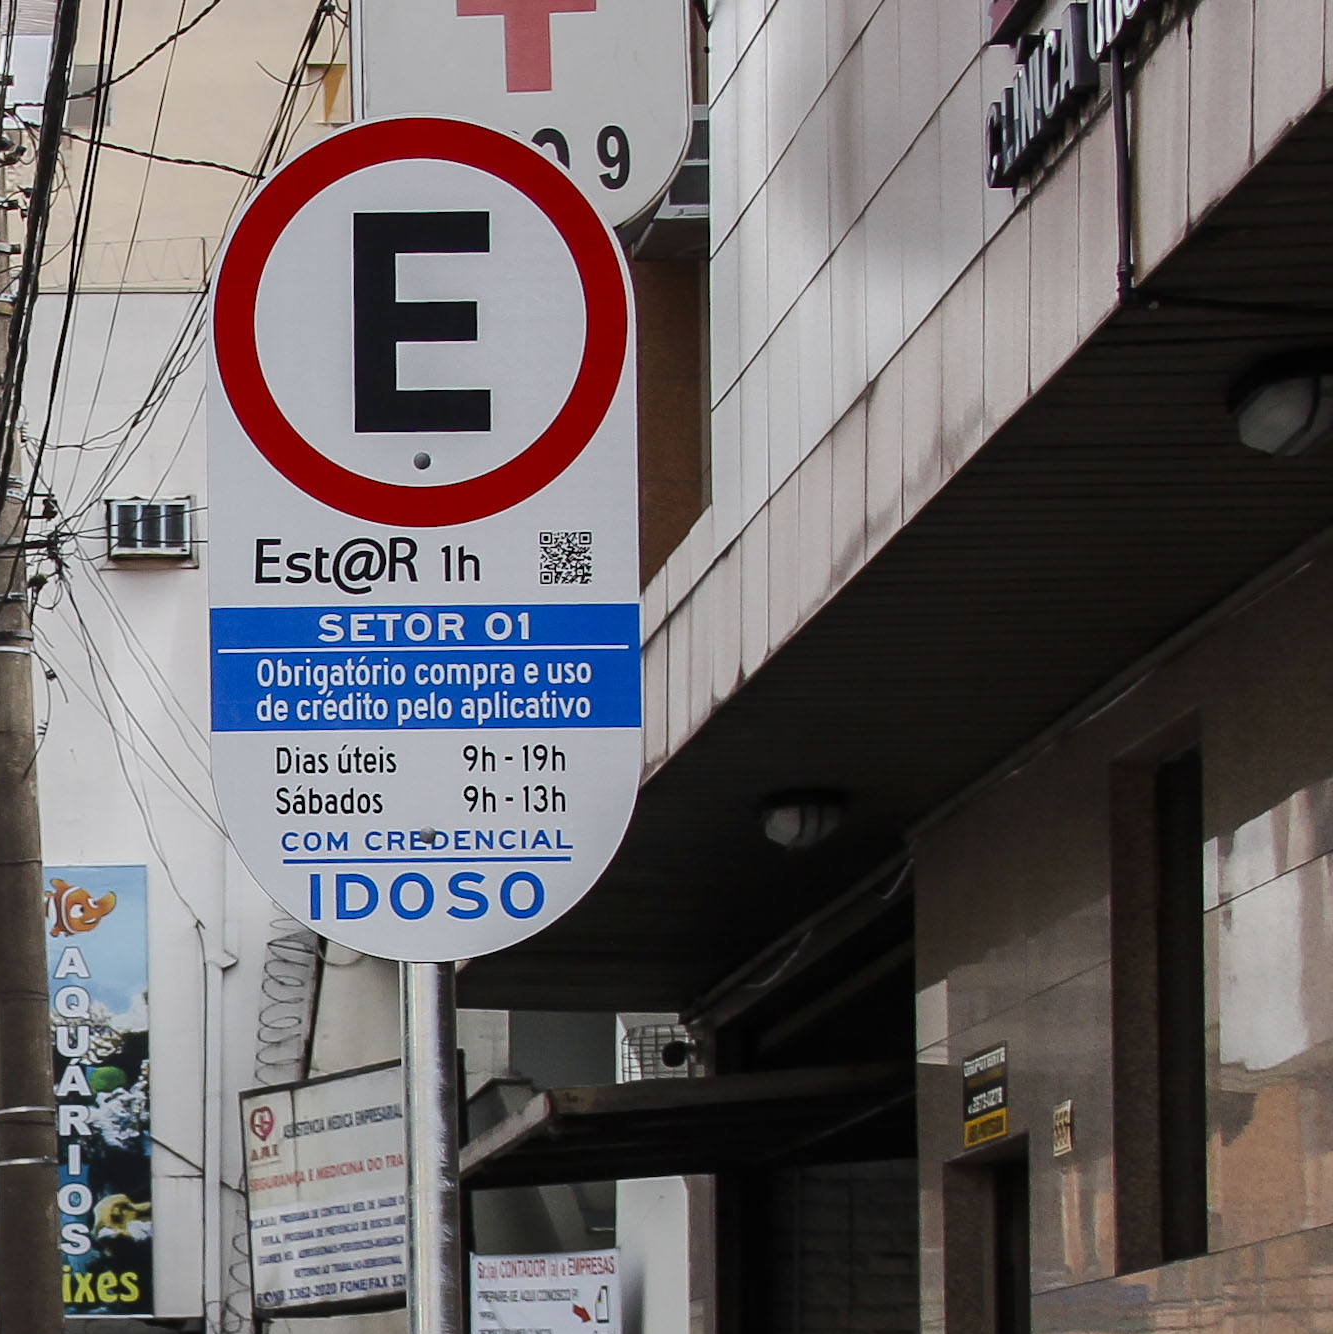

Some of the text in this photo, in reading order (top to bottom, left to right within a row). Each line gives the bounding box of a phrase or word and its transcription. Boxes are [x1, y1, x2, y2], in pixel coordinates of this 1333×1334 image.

[353, 211, 491, 432] E
[254, 536, 481, 594] Est@R 1h
[318, 611, 530, 642] SETOR 01
[256, 656, 591, 695] Obrigatório compra e uso
[256, 689, 591, 726] de crédito pelo aplicativo
[276, 743, 397, 774] Dias úteis
[463, 745, 496, 773] 9h
[522, 743, 567, 772] 19h
[276, 784, 384, 815] Sábados
[463, 785, 496, 814] 9h
[522, 785, 567, 813] 13h
[281, 829, 573, 852] COM CREDENCIAL
[309, 870, 545, 921] IDOSO
[54, 946, 93, 1257] AQUÁRIOS
[316, 1159, 364, 1181] MEDICINA
[366, 1156, 382, 1172] DO
[500, 1258, 546, 1279] CONTADOR
[567, 1256, 615, 1276] EMPRESAS
[62, 1266, 139, 1304] ixes
